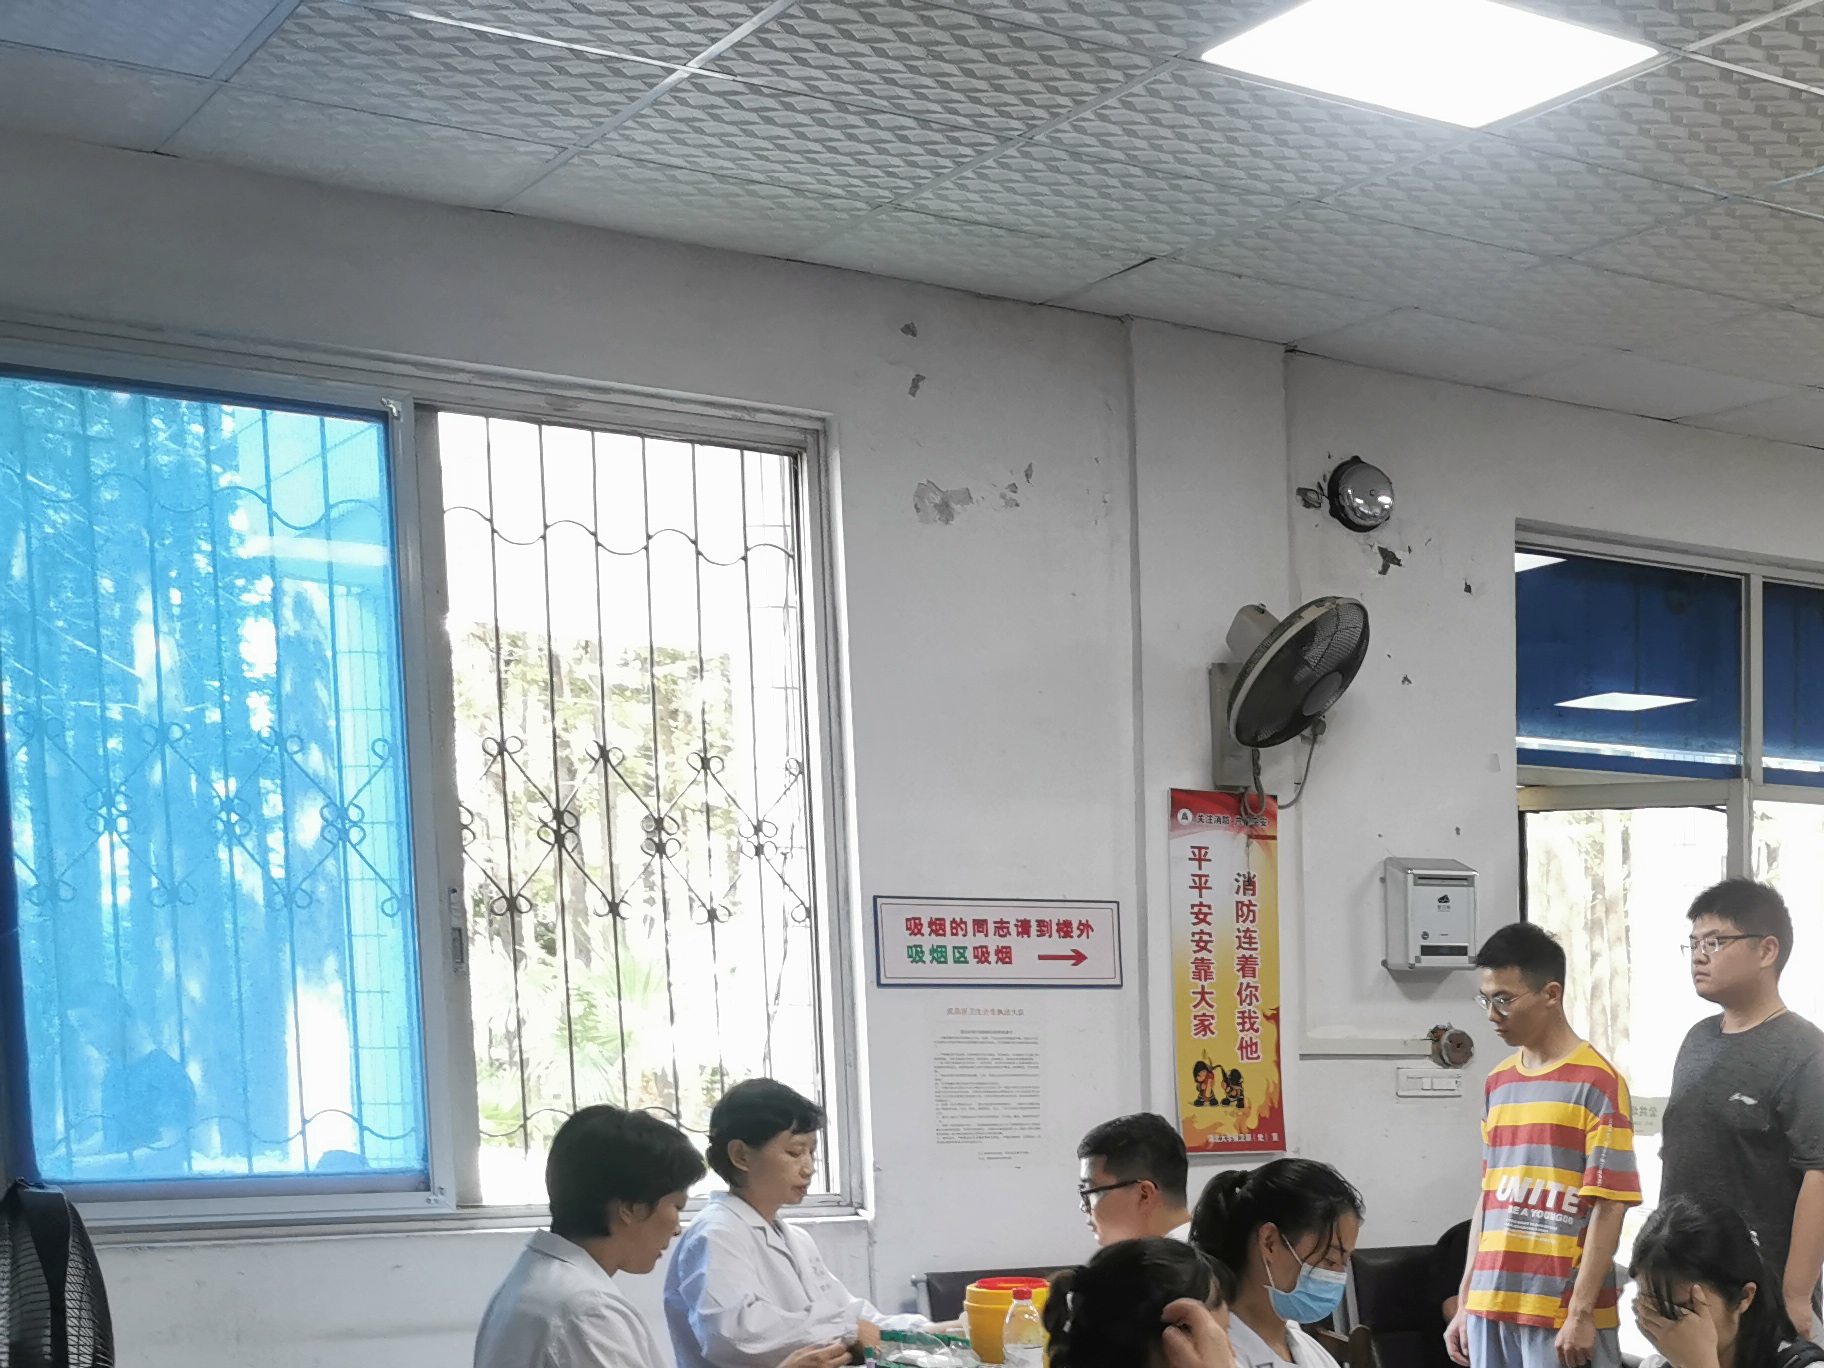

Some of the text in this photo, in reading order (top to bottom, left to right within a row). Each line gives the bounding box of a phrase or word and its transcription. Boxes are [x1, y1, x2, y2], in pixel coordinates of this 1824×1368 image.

[905, 916, 1095, 940] 吸烟的同志请到楼外
[1188, 845, 1216, 1038] 平平安安靠大家
[906, 944, 1013, 965] 吸烟区吸烟
[1234, 871, 1261, 1062] 消防连着你我他
[1495, 1175, 1580, 1214] UNITE
